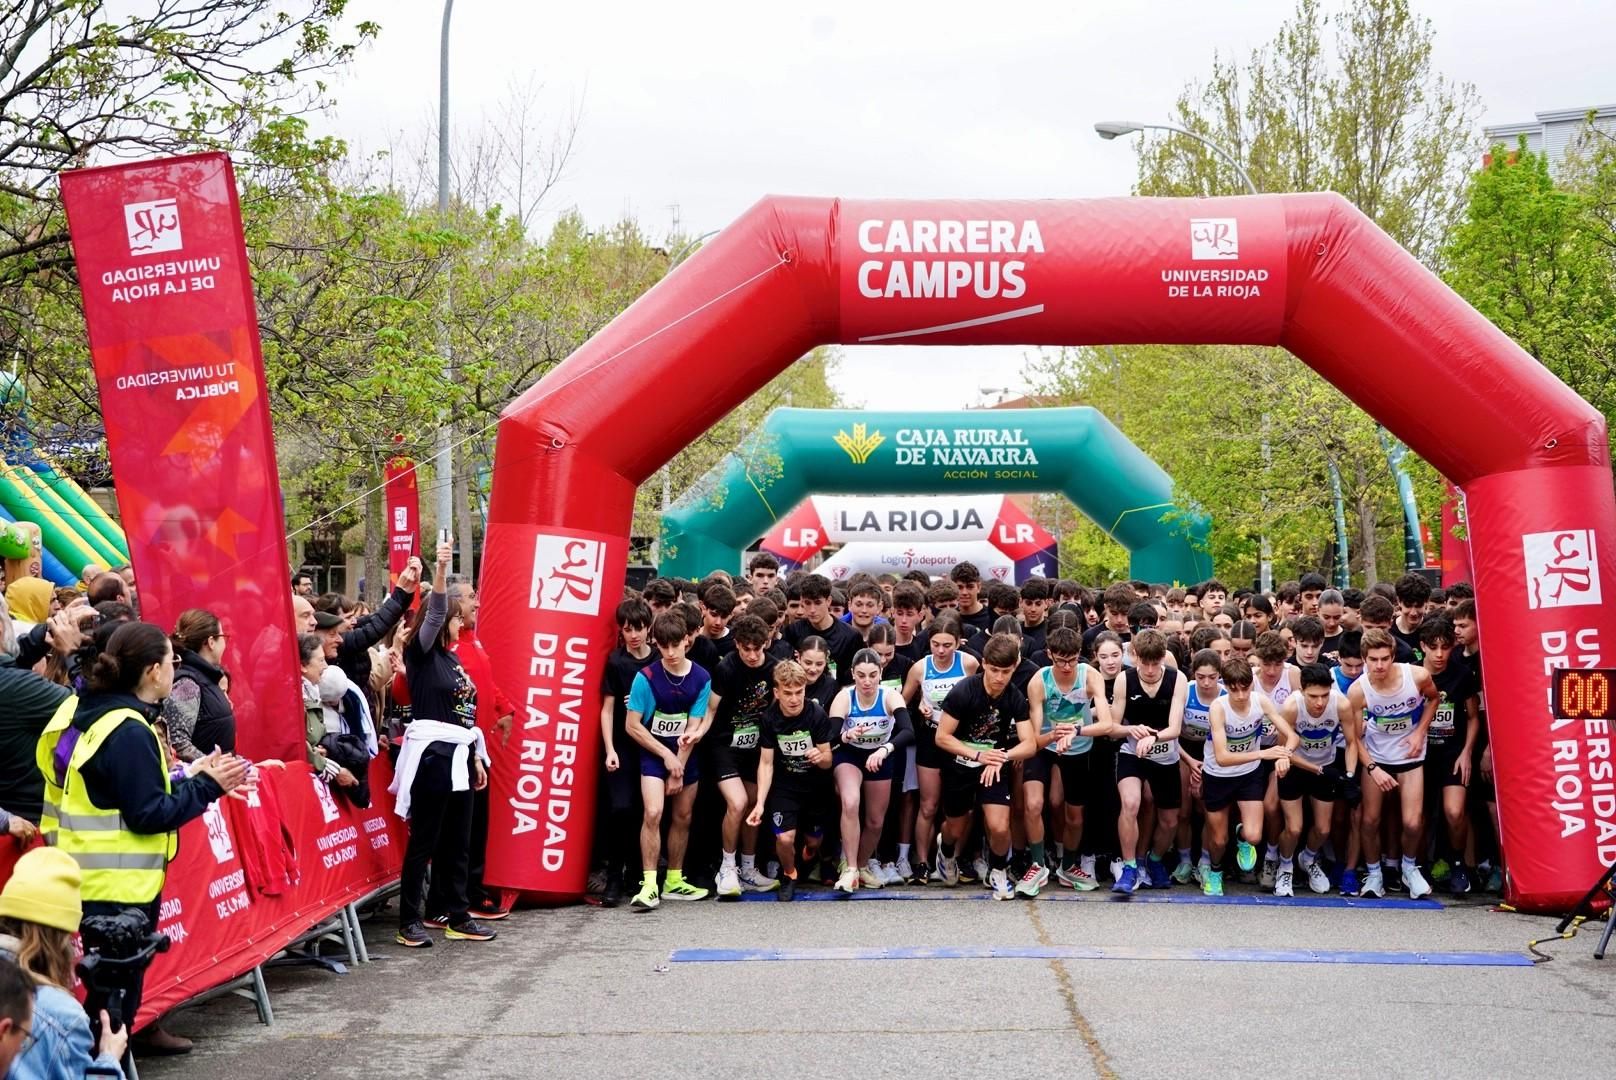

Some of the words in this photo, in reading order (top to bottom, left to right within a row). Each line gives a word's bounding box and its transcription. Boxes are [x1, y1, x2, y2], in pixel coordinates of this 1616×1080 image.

[858, 219, 1045, 254] CARRERA
[858, 260, 1027, 299] CAMPUS
[1161, 269, 1269, 283] UNIVERSIDAD
[1168, 284, 1190, 297] DE
[1193, 284, 1214, 297] LA
[1217, 284, 1261, 299] RIOJA
[895, 429, 947, 448] CAJA
[953, 428, 1029, 446] RURAL
[895, 448, 926, 466] DE
[932, 447, 1039, 466] NAVARRA
[943, 468, 988, 480] ACCIÓN
[994, 470, 1039, 479] SOCIAL
[841, 510, 882, 532] LA
[888, 508, 984, 532] RIOJA
[783, 527, 819, 548] LR
[999, 523, 1035, 544] LR
[529, 632, 559, 677] DE
[1562, 673, 1608, 717] 00
[523, 687, 552, 730] LA
[658, 720, 682, 732] 607
[1383, 721, 1407, 732] 725
[737, 733, 756, 746] 833
[784, 740, 808, 752] 375
[1147, 743, 1169, 755] 288
[1229, 741, 1252, 753] 337
[541, 637, 589, 872] UNIVERSIDAD
[509, 739, 547, 836] RIOJA
[1551, 739, 1586, 838] RIOJA
